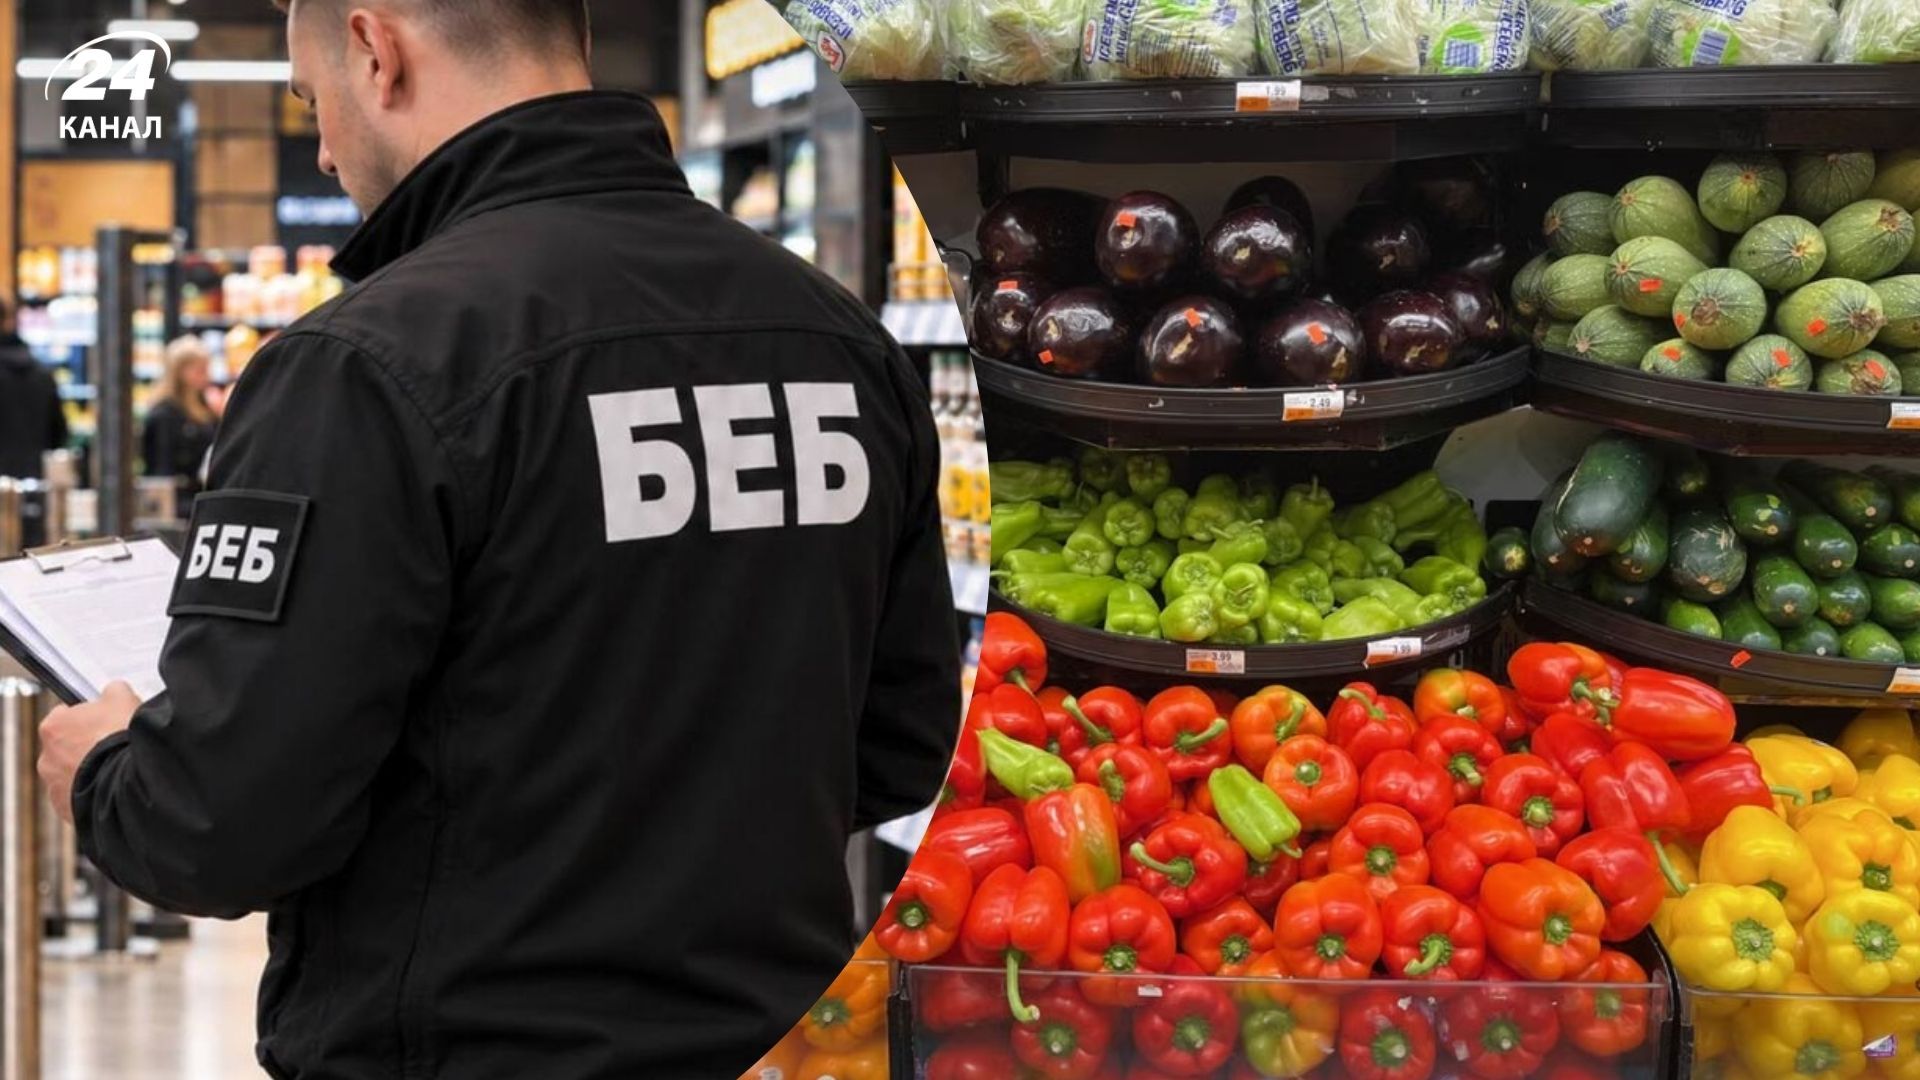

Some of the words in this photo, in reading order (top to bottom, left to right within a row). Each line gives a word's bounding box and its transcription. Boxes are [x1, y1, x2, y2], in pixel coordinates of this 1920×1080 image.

[1268, 5, 1299, 73] ICEBERG
[1265, 84, 1287, 97] 1.99
[1309, 397, 1331, 408] 2.49
[587, 381, 871, 543] БЕБ
[185, 523, 280, 584] БЕБ
[1211, 651, 1232, 661] 3.99
